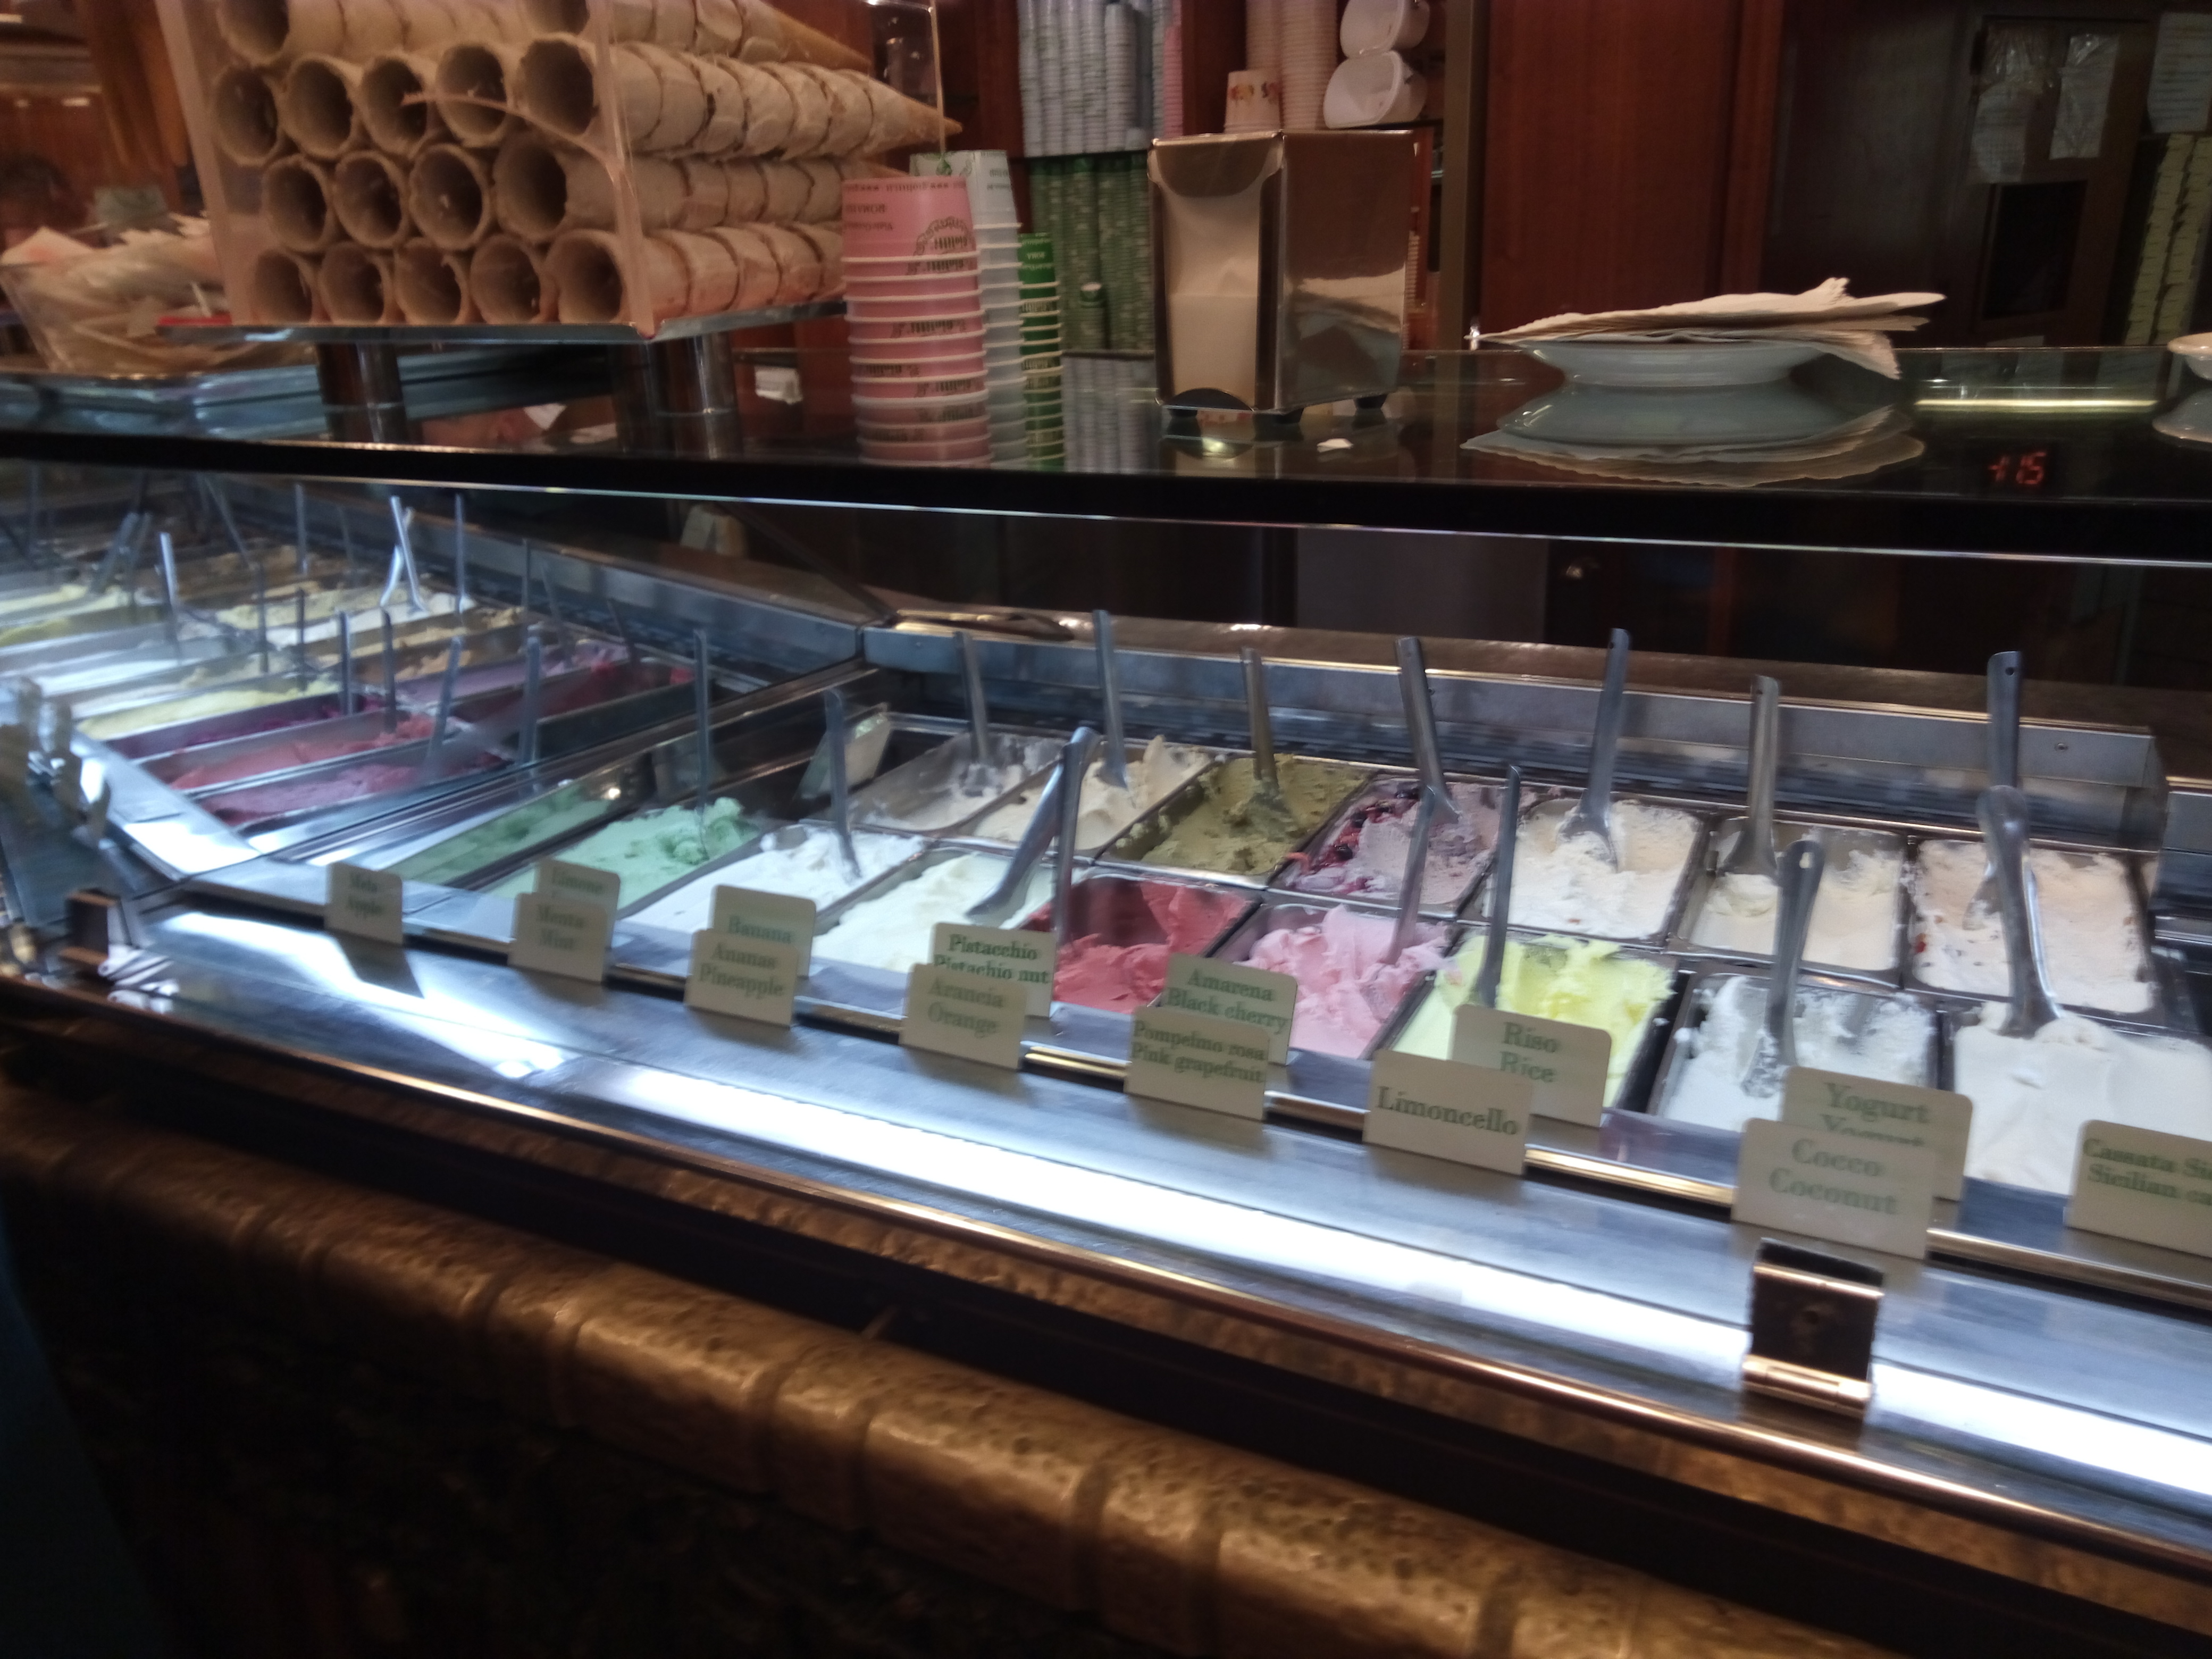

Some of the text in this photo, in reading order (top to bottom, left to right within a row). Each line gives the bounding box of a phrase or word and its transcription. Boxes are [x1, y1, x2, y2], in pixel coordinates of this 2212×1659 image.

[728, 915, 793, 944] Banana
[948, 933, 1039, 960] Pistacchio
[713, 942, 777, 969] Ananas
[698, 964, 785, 1000] Pineapple
[928, 977, 1004, 1008] Arancia
[1017, 969, 1050, 984] nut
[1188, 968, 1274, 1001] Amarena
[927, 1001, 999, 1038] Orange
[1167, 987, 1292, 1035] Black cherry
[1133, 1019, 1223, 1053] Pompelmo
[1503, 1020, 1559, 1053] Riso
[1130, 1042, 1263, 1083] Pink grapefruit
[1499, 1050, 1555, 1083] Rice
[1377, 1085, 1518, 1135] Limoncello
[1824, 1082, 1930, 1124] Yogurt
[1791, 1138, 1883, 1176] Cocco
[1769, 1167, 1898, 1215] Coconut
